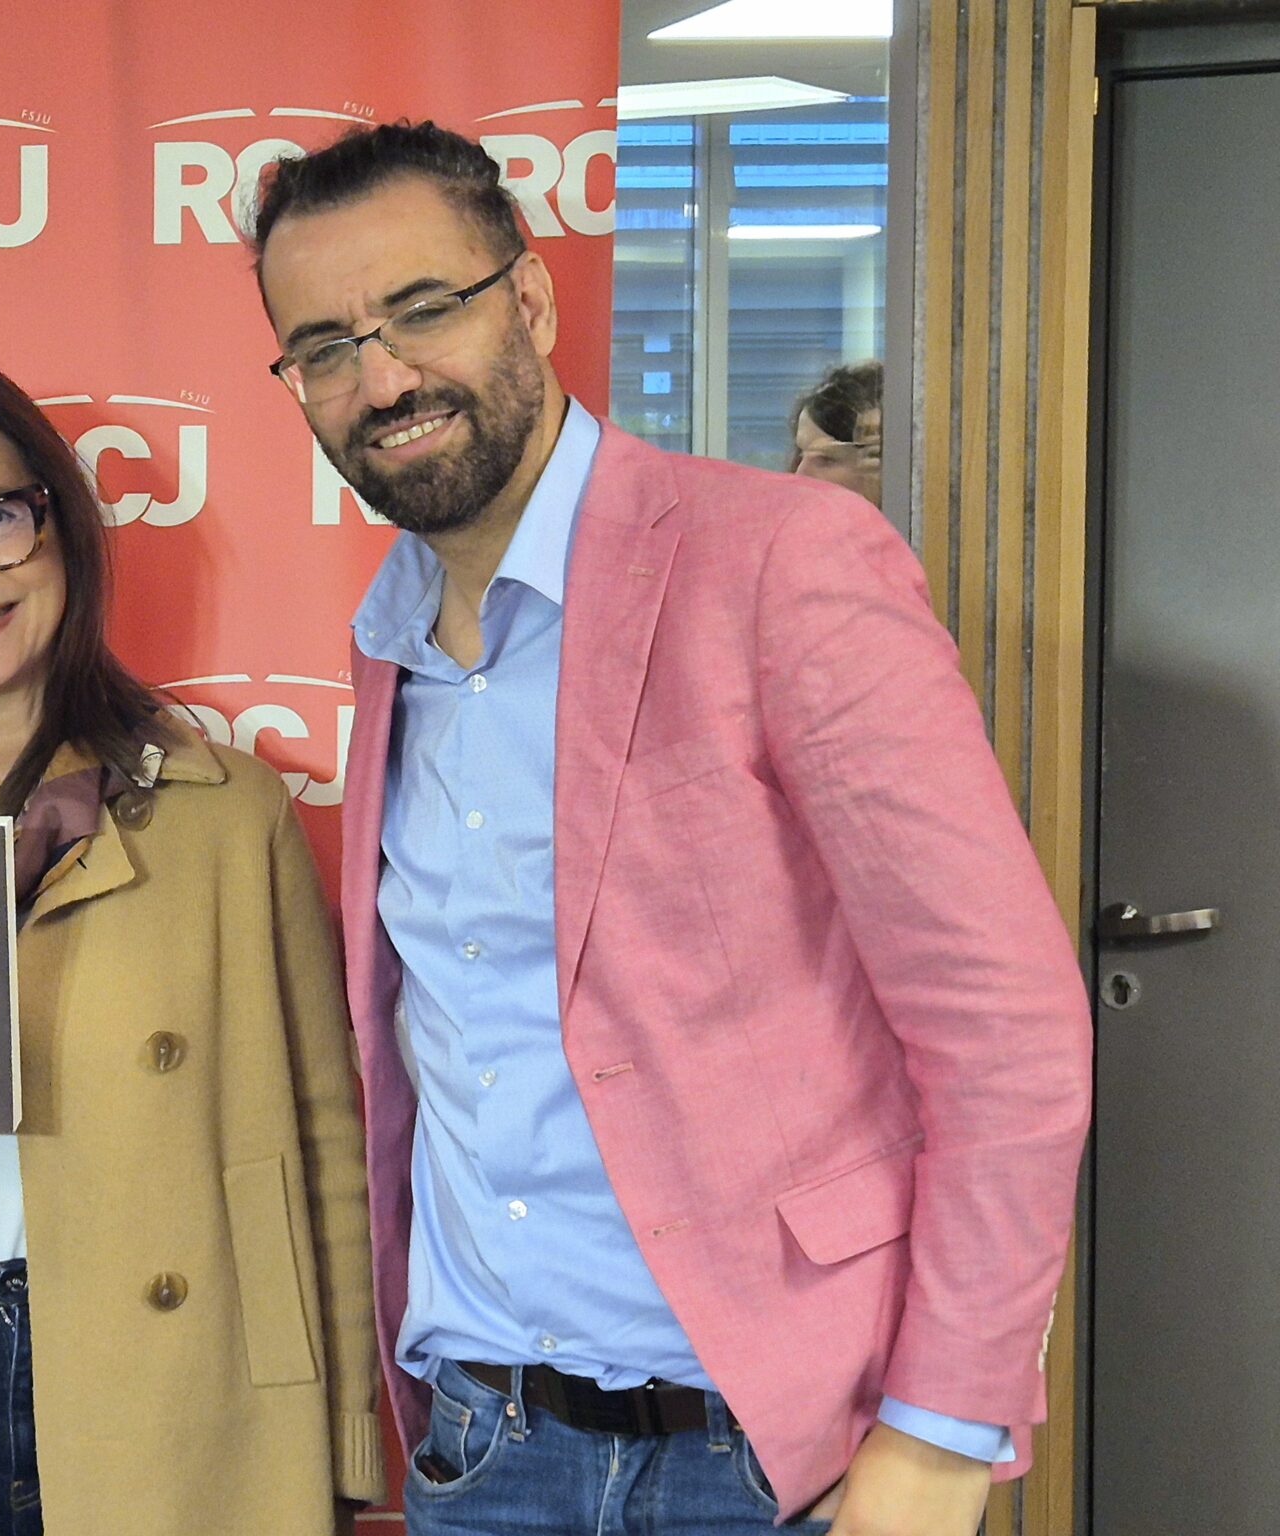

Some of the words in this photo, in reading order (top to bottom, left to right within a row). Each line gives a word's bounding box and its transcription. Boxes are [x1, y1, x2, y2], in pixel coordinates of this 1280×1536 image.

[21, 108, 52, 125] FSJU
[343, 101, 375, 118] FSJU
[480, 129, 616, 239] RC
[180, 389, 210, 405] FSJU
[77, 424, 208, 527] CJ
